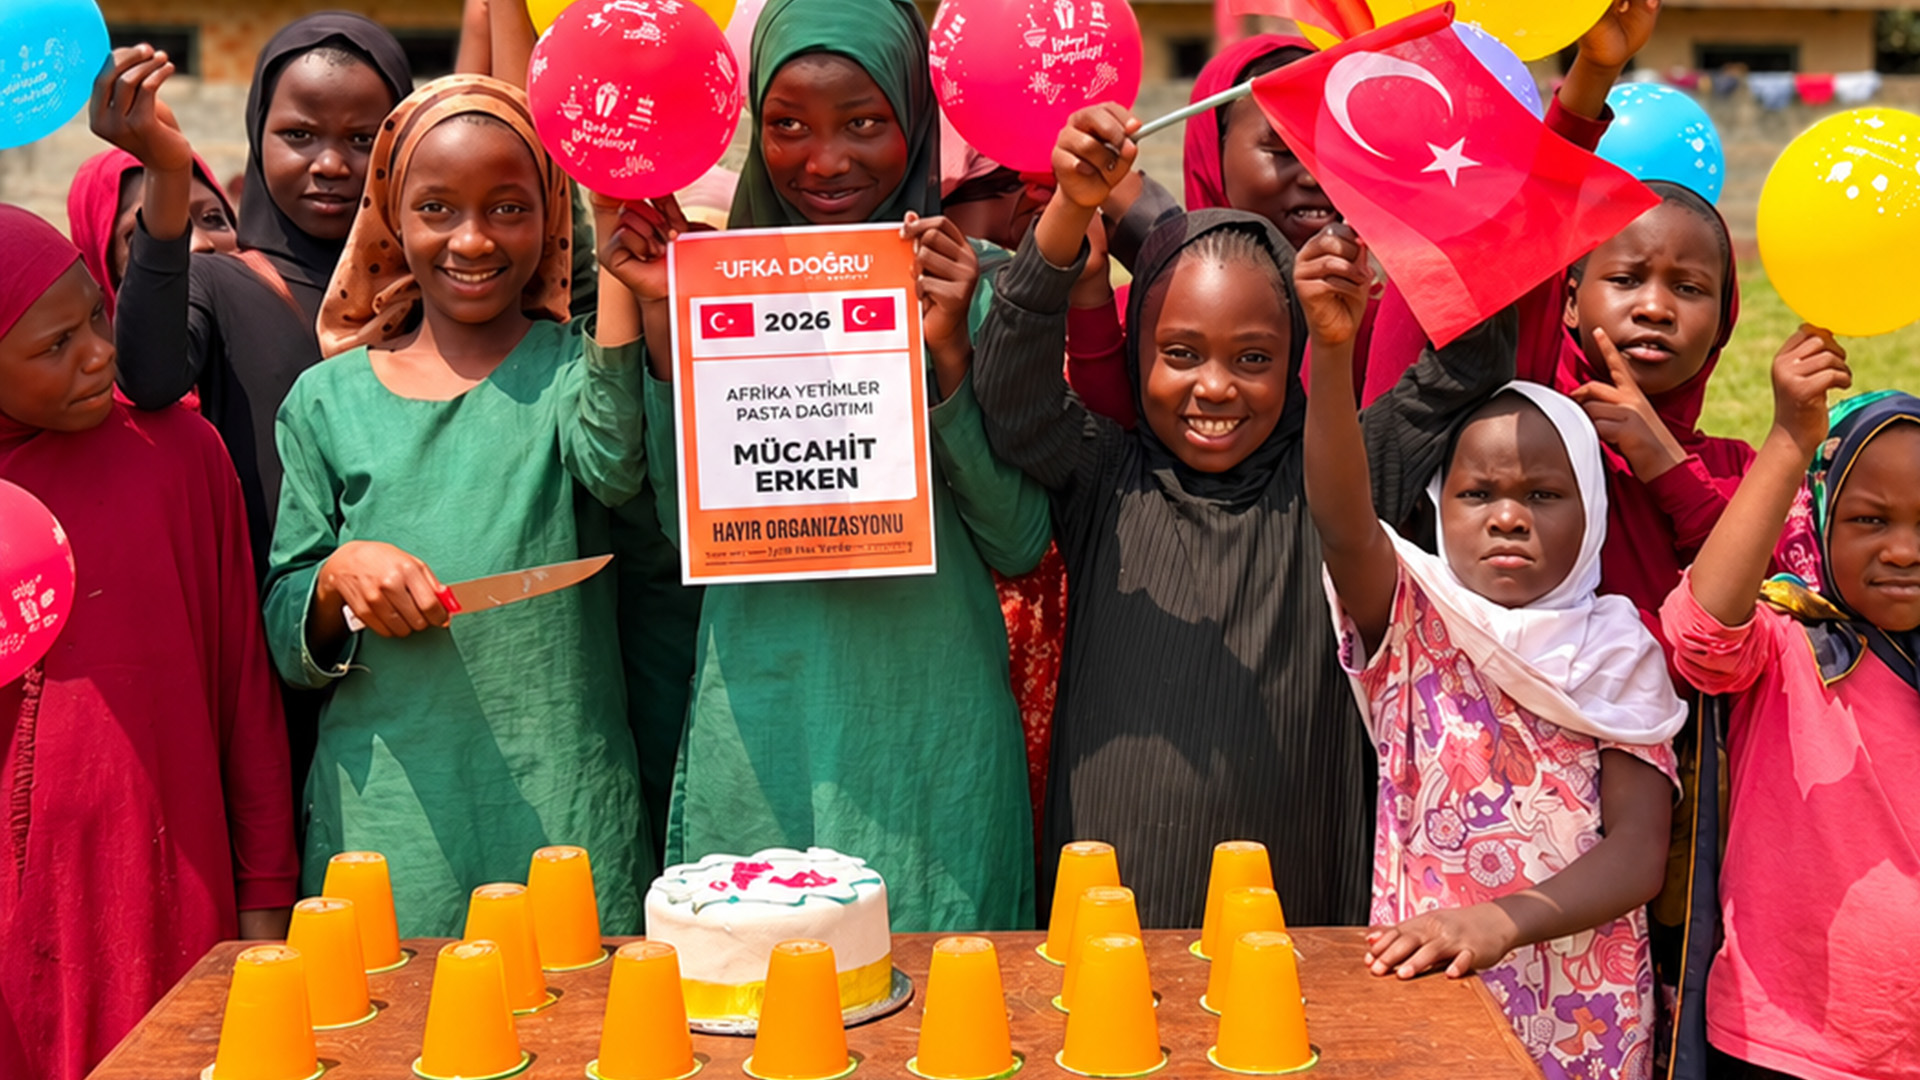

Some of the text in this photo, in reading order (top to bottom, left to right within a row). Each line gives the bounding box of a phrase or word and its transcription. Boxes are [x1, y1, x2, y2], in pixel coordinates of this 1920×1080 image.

[722, 257, 784, 279] UFKA
[788, 251, 869, 276] DOĞRU
[764, 310, 831, 332] 2026
[726, 379, 880, 402] AFRİKA YETİMLER
[736, 405, 792, 422] PASTA
[733, 432, 877, 466] MÜCAHİT
[755, 466, 859, 493] ERKEN
[712, 519, 762, 543] HAYIR
